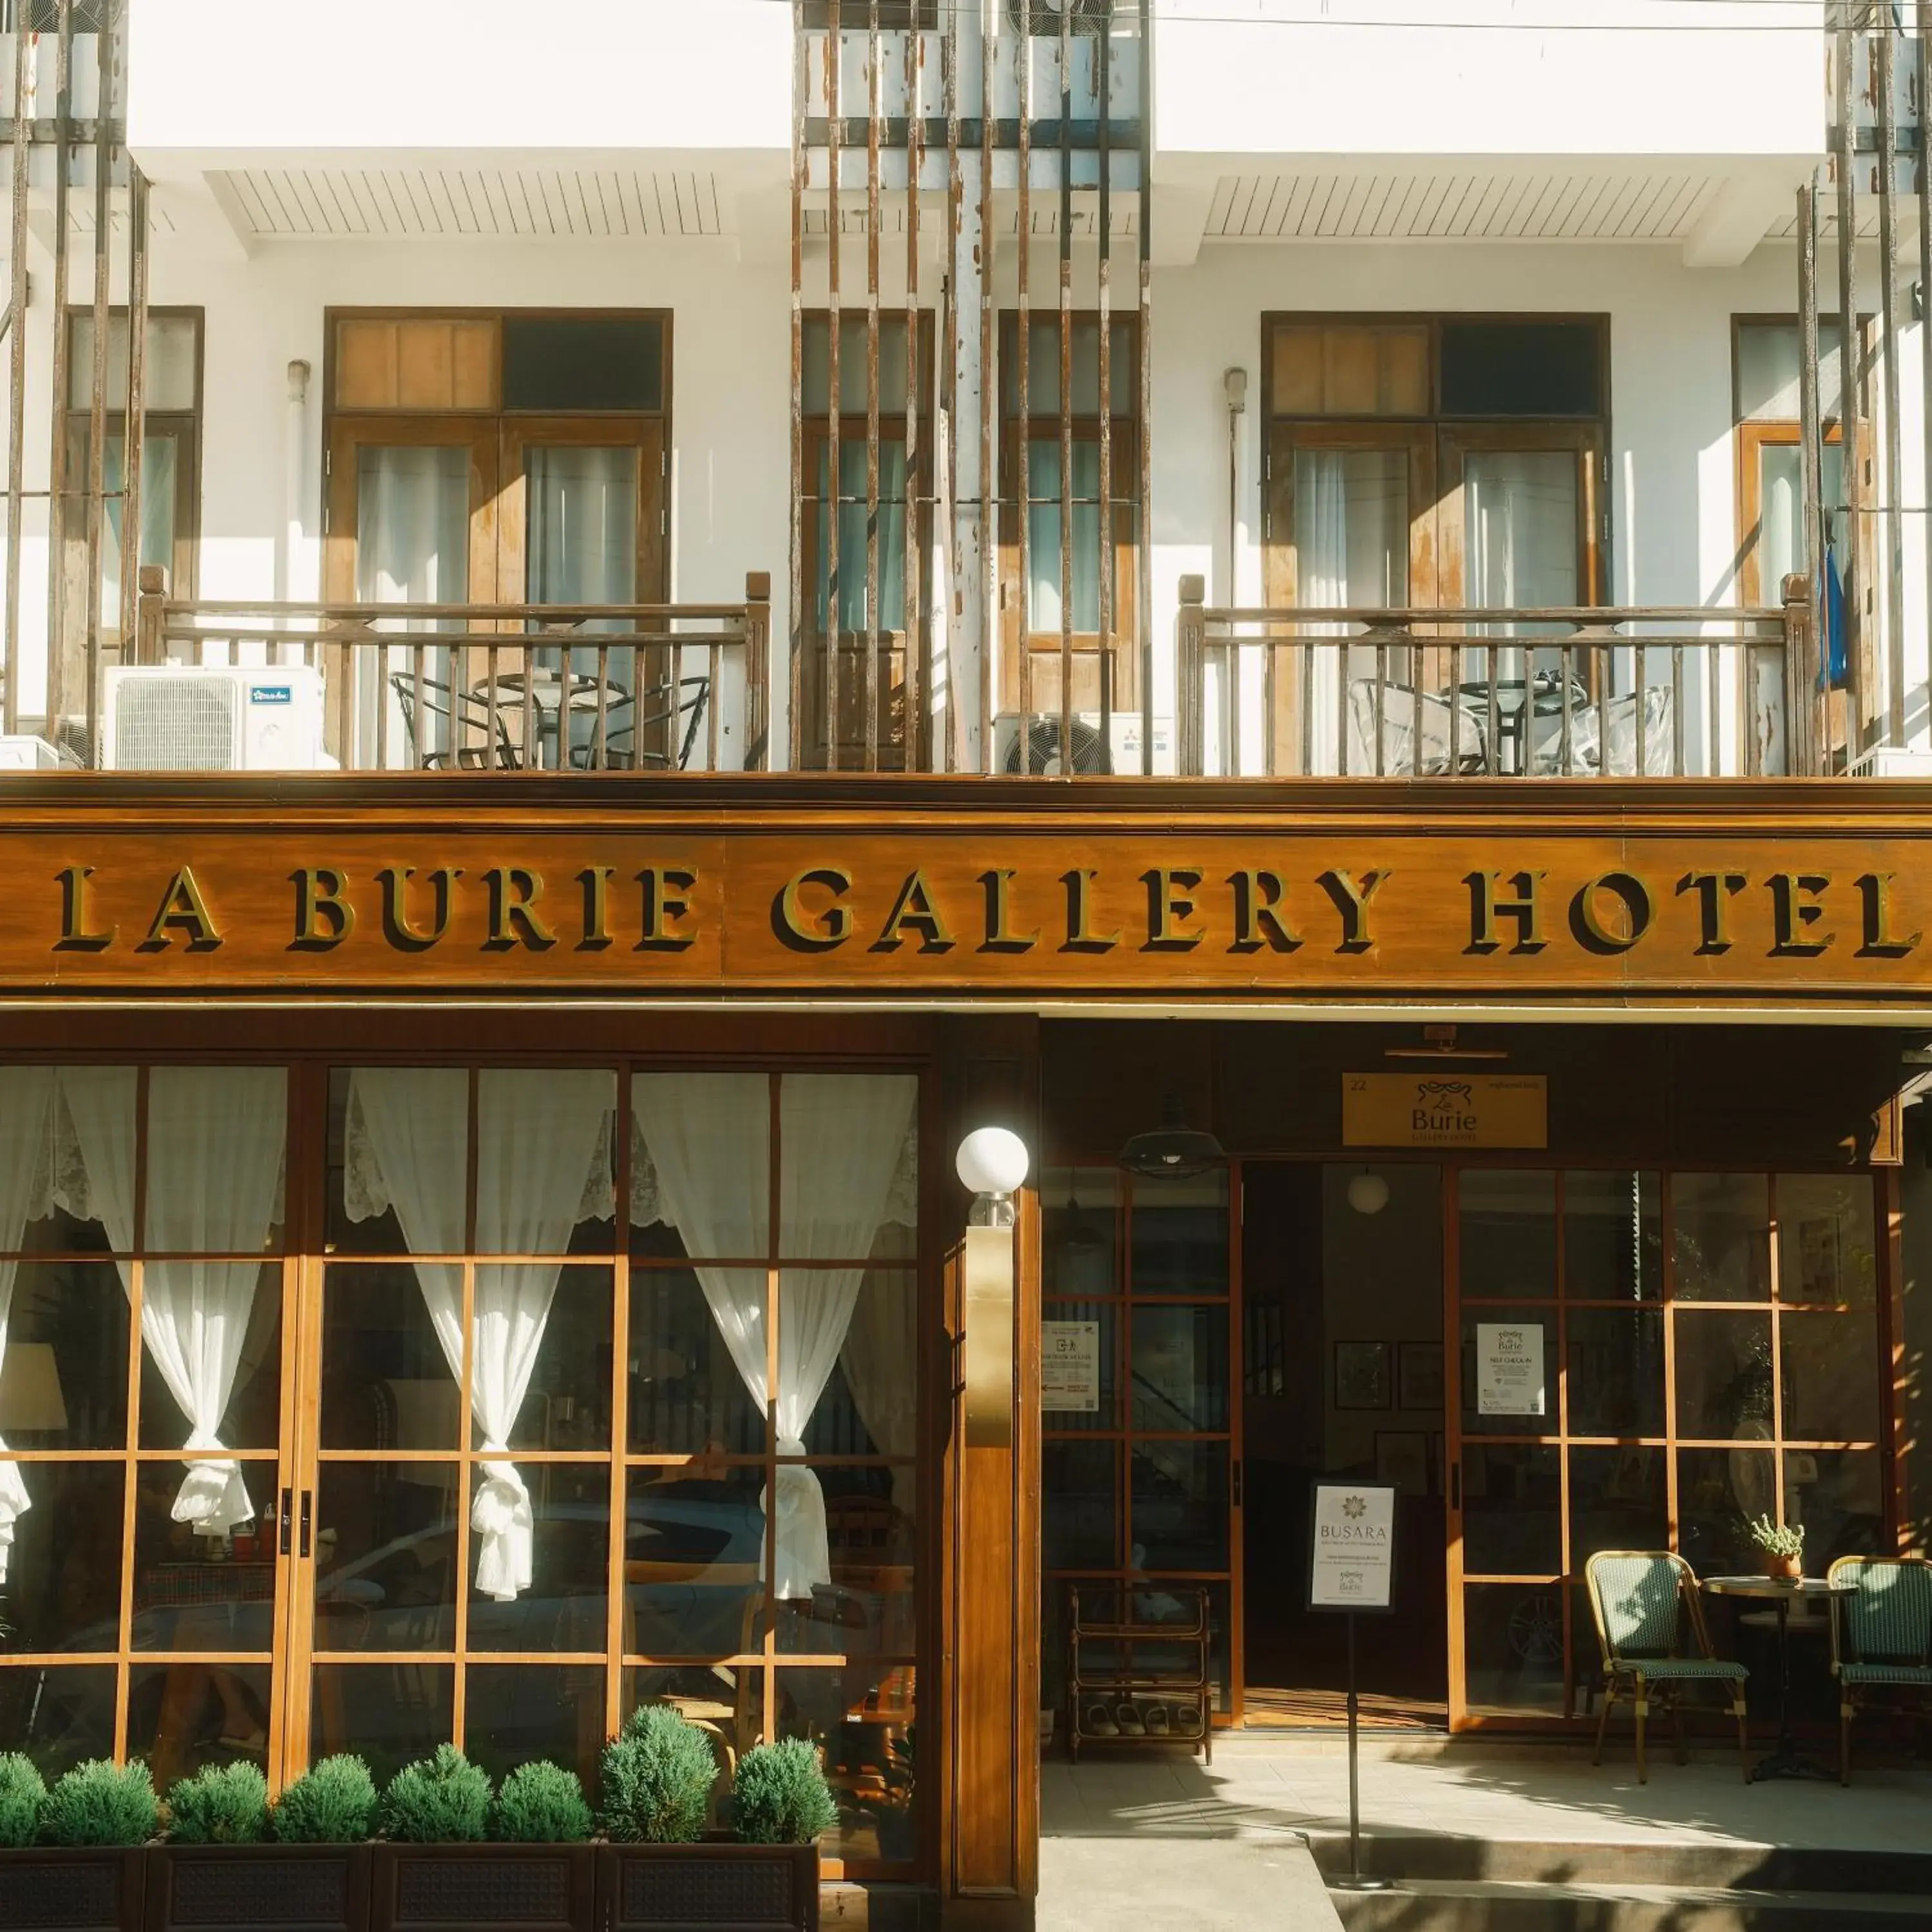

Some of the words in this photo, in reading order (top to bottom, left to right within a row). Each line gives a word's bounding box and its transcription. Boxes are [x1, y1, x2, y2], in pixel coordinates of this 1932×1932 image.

[53, 864, 225, 952] LA
[288, 864, 699, 952] BURIE
[770, 867, 1391, 954] GALLERY
[1461, 869, 1922, 958] HOTEL
[1412, 1109, 1477, 1131] Burie
[1321, 1525, 1386, 1539] BUSARA
